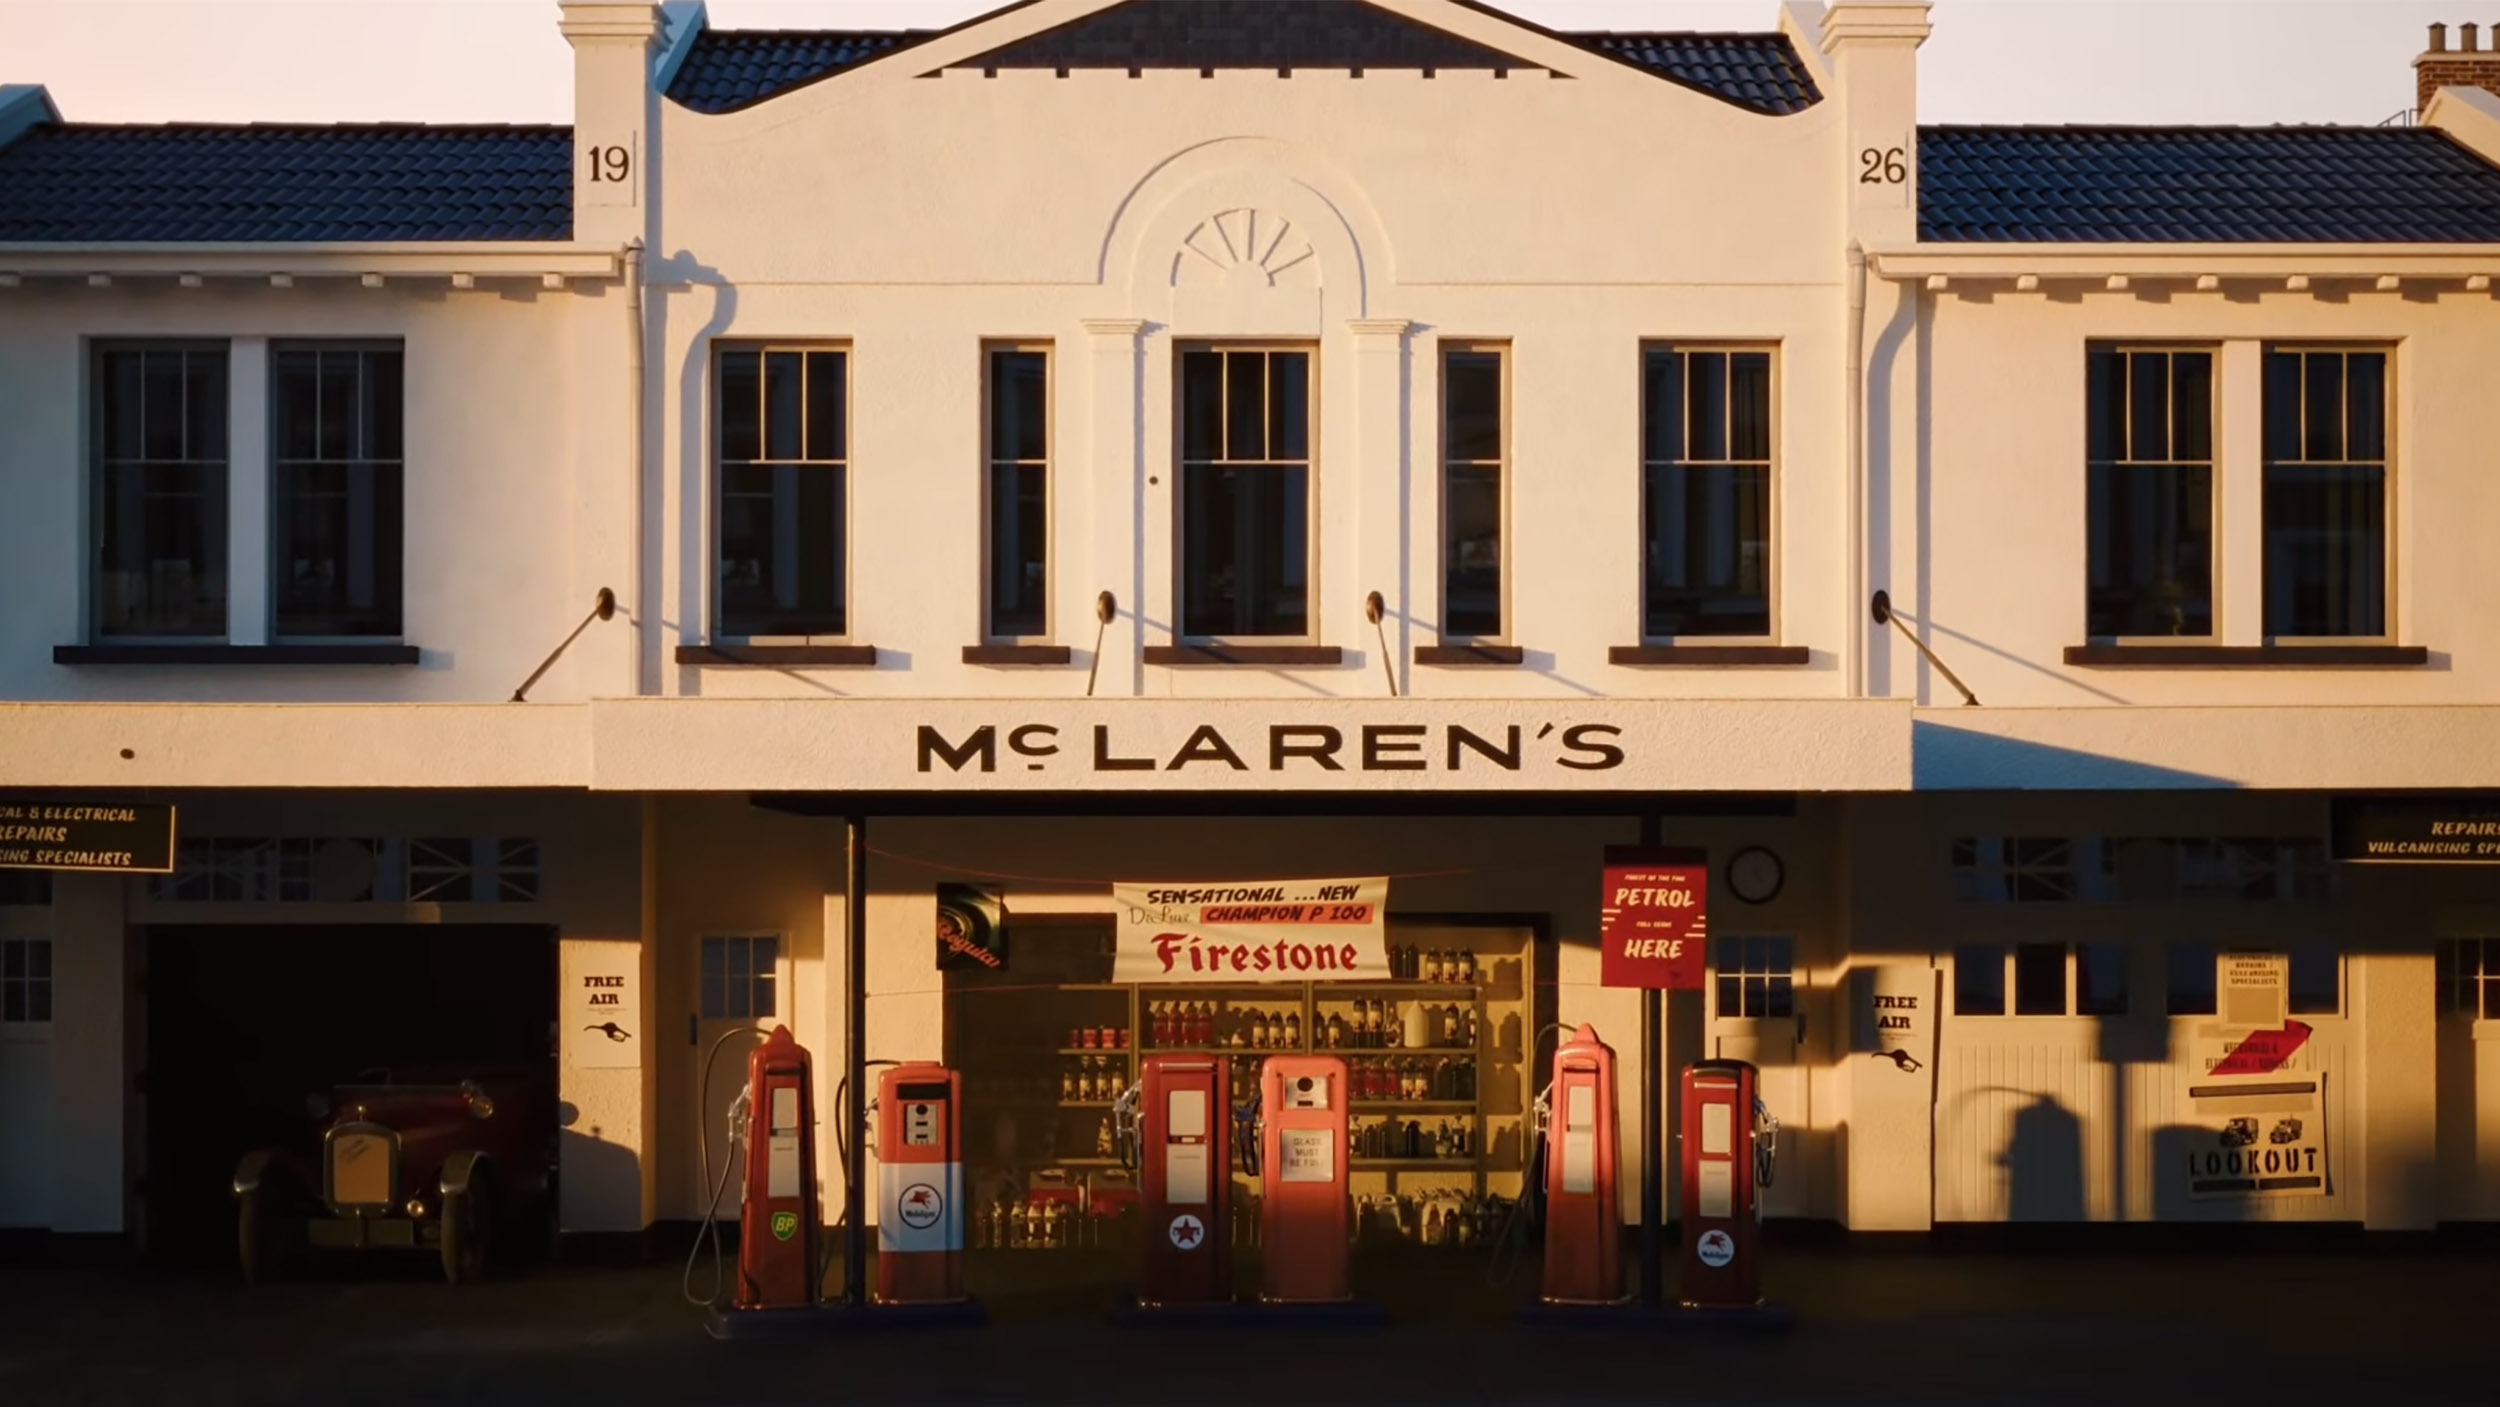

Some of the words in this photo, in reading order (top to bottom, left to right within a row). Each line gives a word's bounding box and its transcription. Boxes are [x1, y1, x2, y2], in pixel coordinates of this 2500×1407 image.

[588, 145, 629, 182] 19
[1860, 147, 1906, 184] 26
[44, 807, 136, 822] ELECTRICAL
[2367, 841, 2471, 854] VULCANISING
[36, 849, 132, 866] SPECIALISTS
[1147, 887, 1285, 905] SENSATIONAL
[1614, 888, 1695, 908] PETROL
[1206, 904, 1304, 922] CHAMPION
[1309, 905, 1324, 921] P
[1329, 905, 1367, 921] 100
[1151, 932, 1358, 974] Firestone
[1624, 938, 1683, 959] HERE
[583, 976, 625, 988] FREE
[589, 993, 619, 1005] AIR
[1873, 995, 1918, 1009] FREE
[1878, 1015, 1911, 1029] AIR
[2190, 1147, 2317, 1177] LOOKOUT
[775, 1216, 795, 1232] BP
